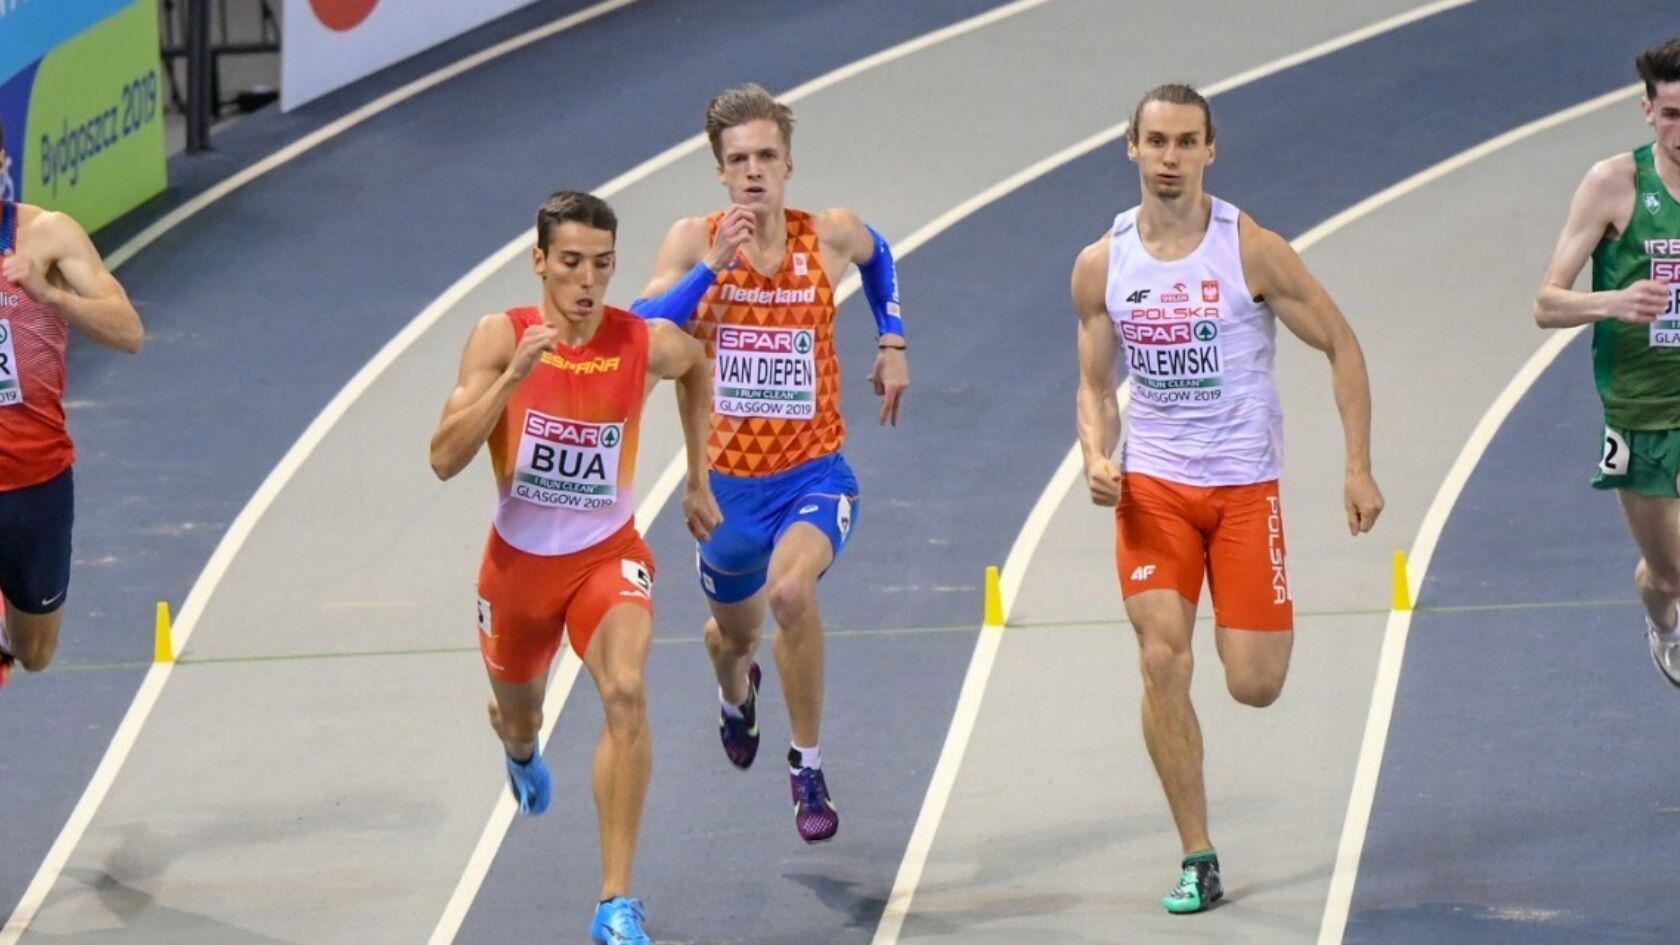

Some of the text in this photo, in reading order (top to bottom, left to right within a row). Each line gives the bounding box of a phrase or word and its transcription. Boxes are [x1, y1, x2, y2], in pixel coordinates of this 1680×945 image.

[41, 71, 157, 198] Bydgoszcz 2019
[1131, 306, 1220, 321] POLSKA
[721, 330, 792, 349] SPAR
[1122, 324, 1190, 342] SPAR
[719, 355, 812, 386] VAN DIEPEN
[1128, 345, 1220, 375] ZALEWSKI
[741, 389, 760, 398] RUN
[763, 391, 794, 399] CLEAN
[1195, 389, 1222, 401] 2019
[720, 400, 812, 415] GLASGOW 2019
[527, 416, 598, 444] SPAR
[531, 443, 606, 480] BUA
[1605, 437, 1619, 469] 2
[516, 485, 582, 506] GLASGOW
[540, 479, 559, 489] RUN
[562, 482, 594, 493] CLEAN
[1266, 496, 1286, 604] POLSKA
